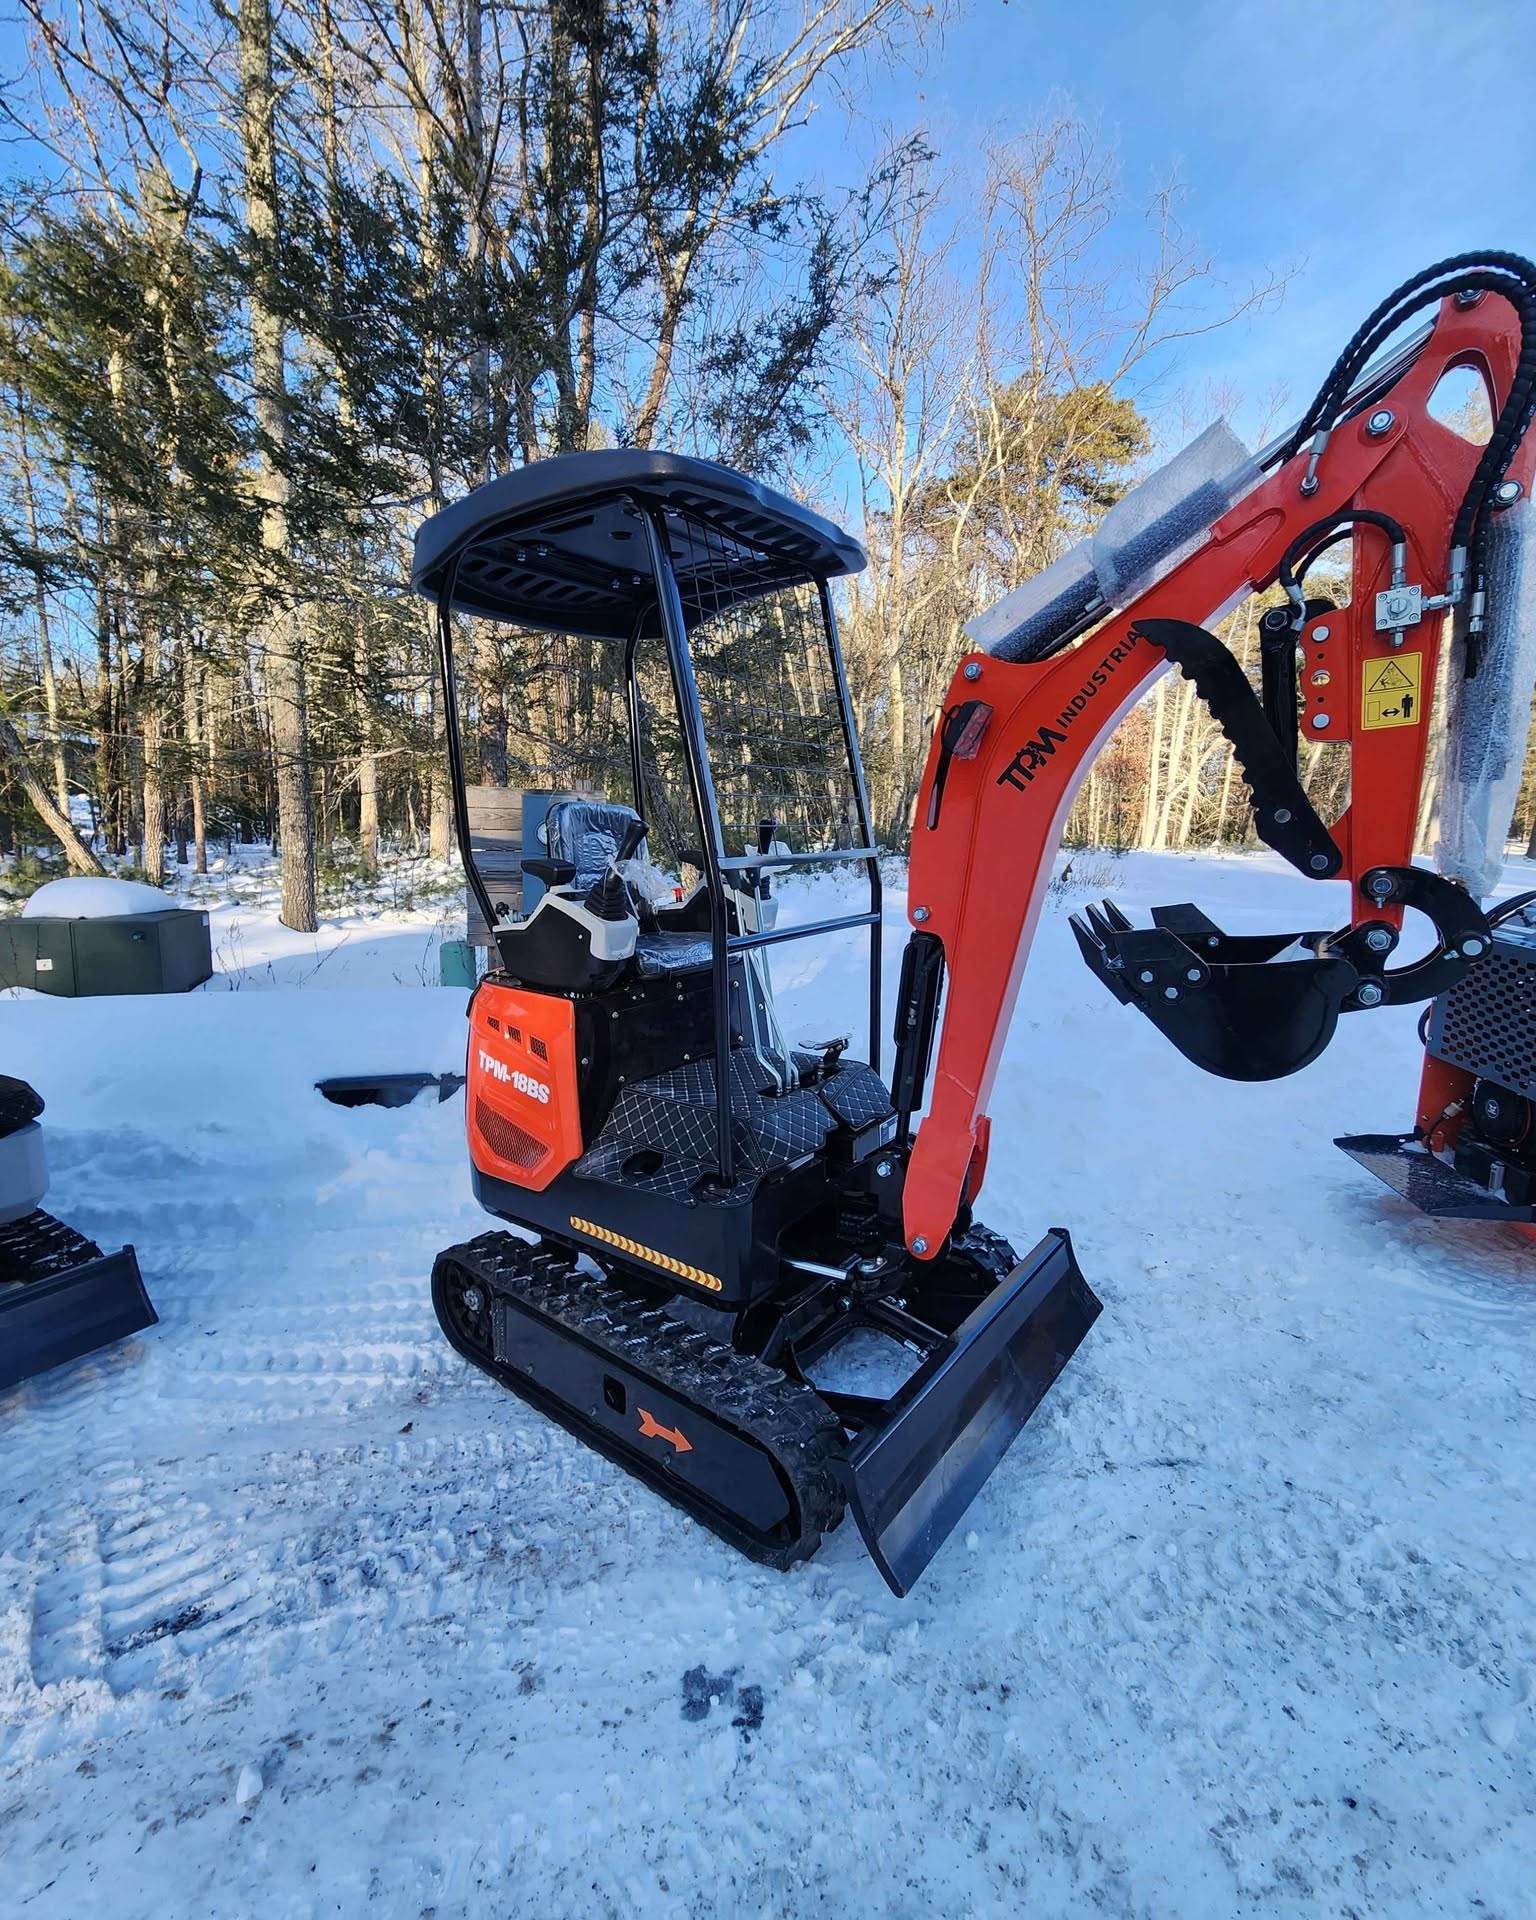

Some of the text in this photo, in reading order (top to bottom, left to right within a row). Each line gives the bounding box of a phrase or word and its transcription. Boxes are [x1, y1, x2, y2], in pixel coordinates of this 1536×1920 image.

[996, 630, 1141, 792] TPM INDUSTRIA
[479, 1049, 550, 1104] TPM-18BS
